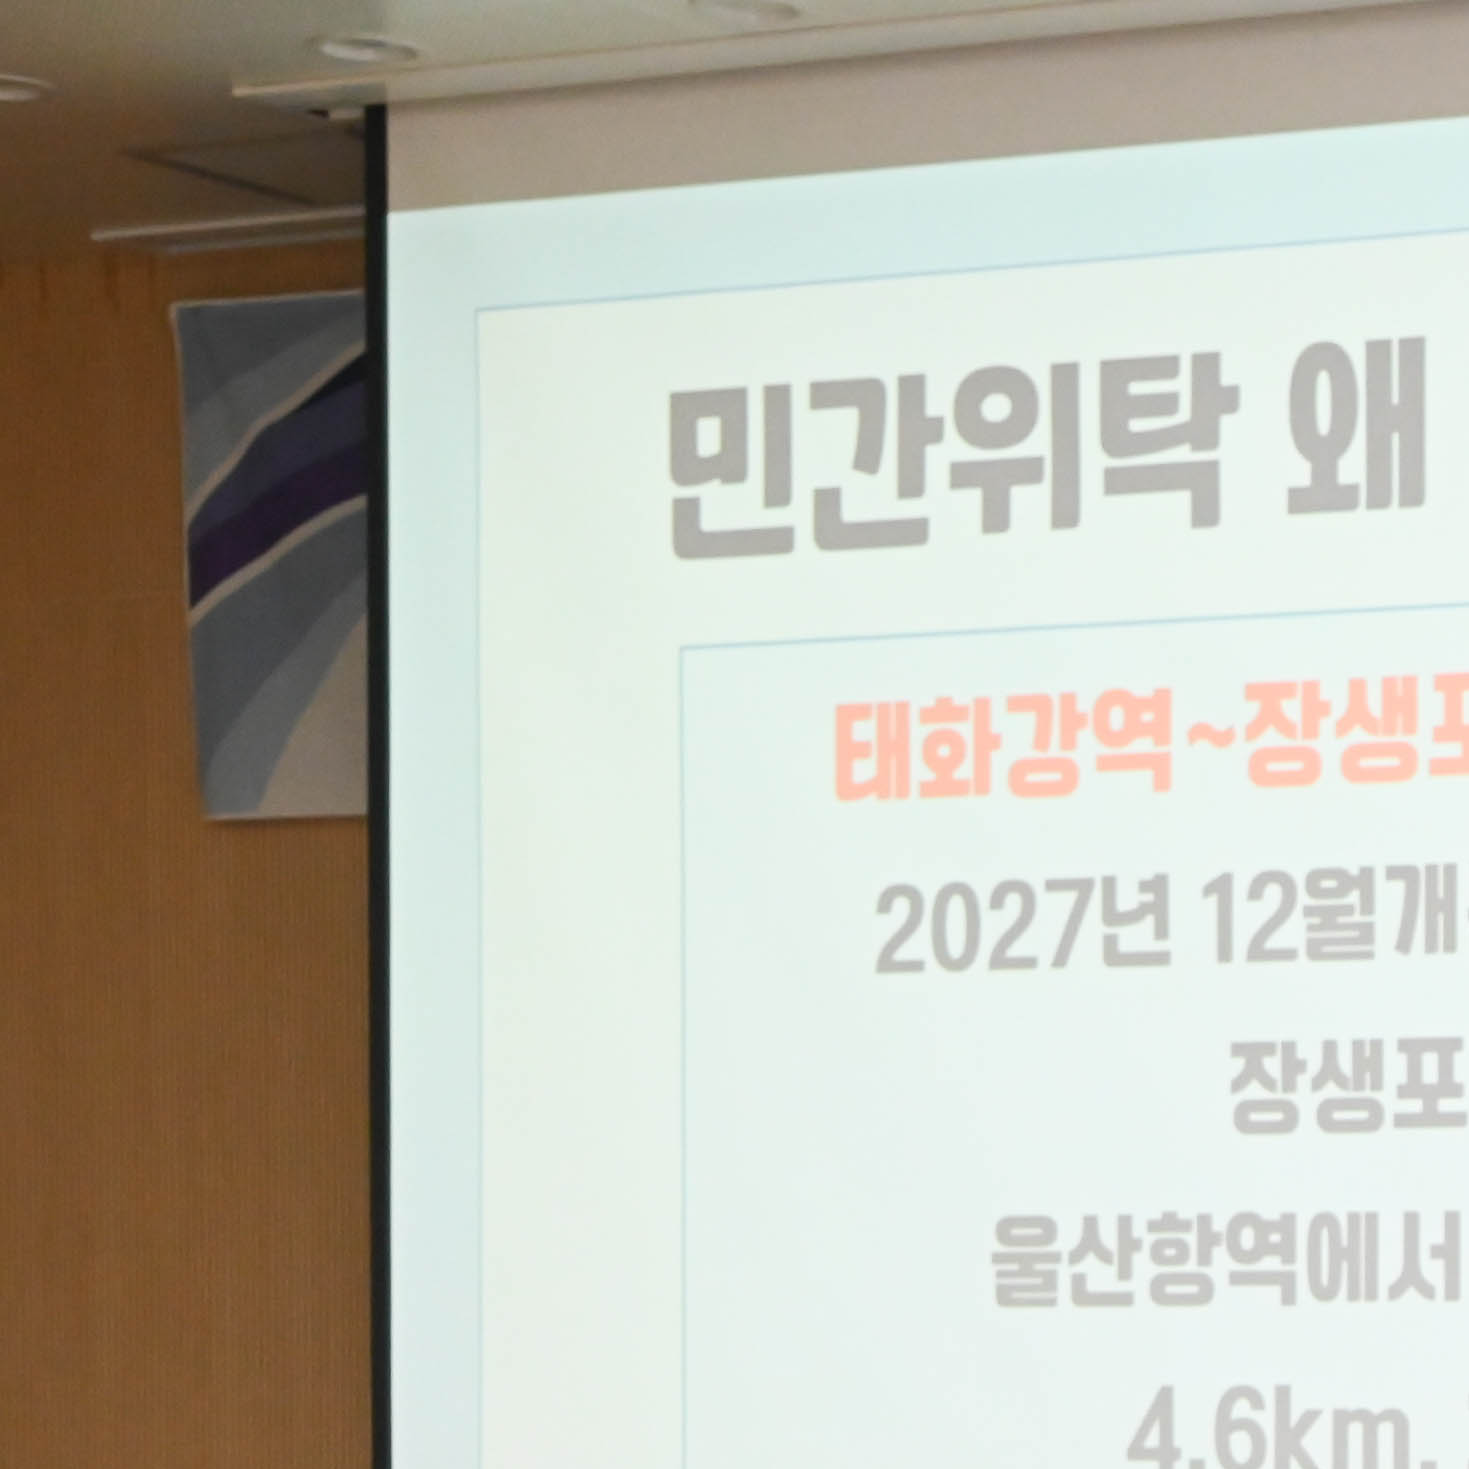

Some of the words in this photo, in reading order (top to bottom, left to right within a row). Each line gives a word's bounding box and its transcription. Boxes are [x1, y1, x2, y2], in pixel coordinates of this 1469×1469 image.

[668, 351, 1241, 560] 민간위탁
[1286, 335, 1426, 515] 왜
[874, 872, 1173, 975] 2027년
[990, 1210, 1462, 1307] 울산항역에서
